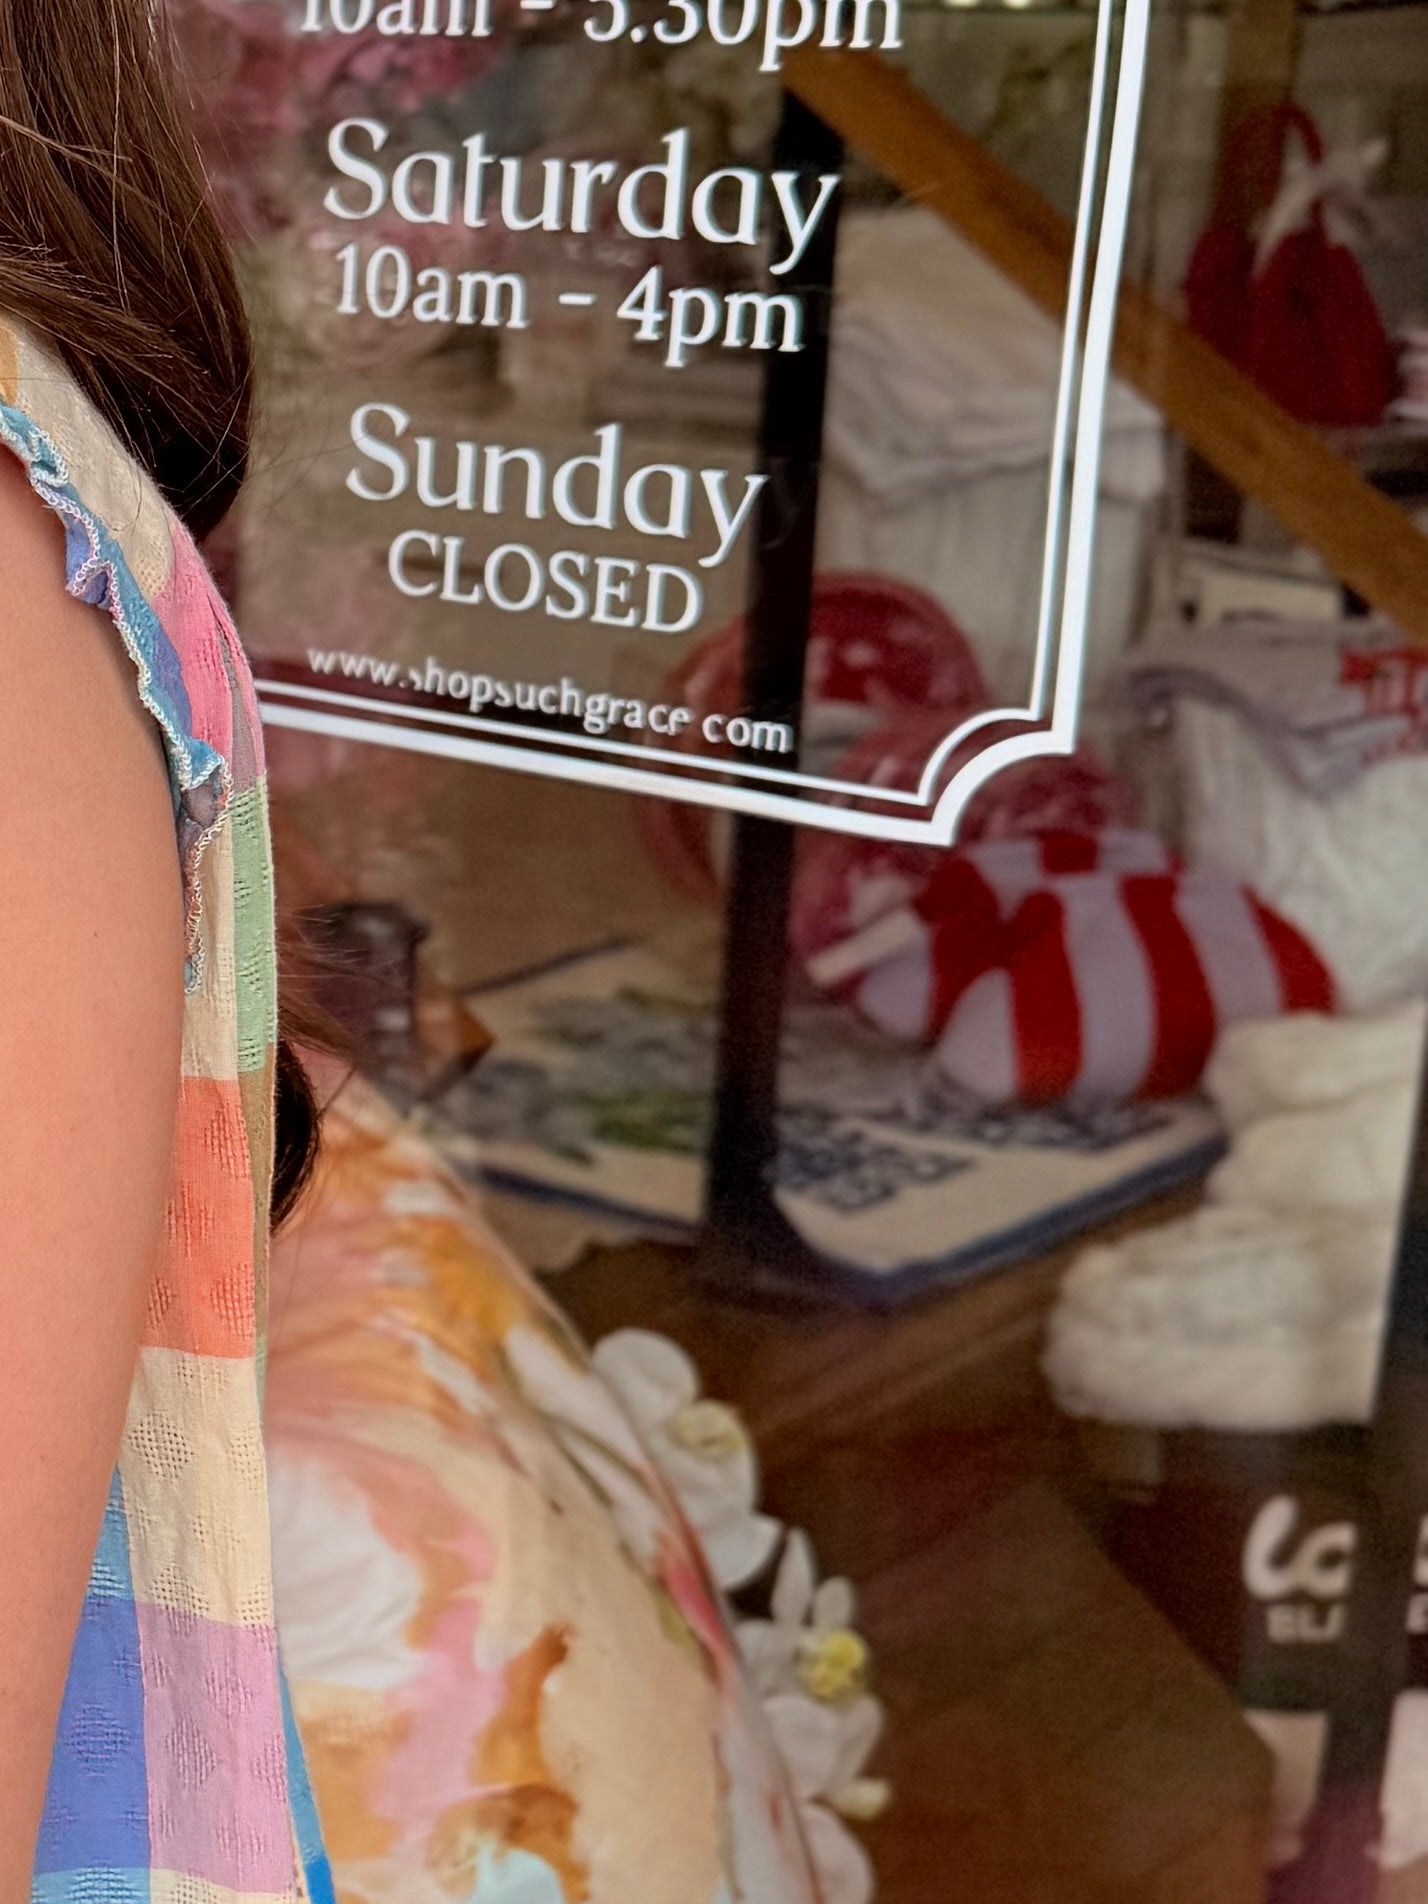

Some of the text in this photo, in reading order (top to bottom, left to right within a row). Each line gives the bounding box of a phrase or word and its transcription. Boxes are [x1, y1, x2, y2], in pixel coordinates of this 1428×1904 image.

[323, 116, 841, 275] Saturday
[334, 243, 528, 329] 10am
[617, 265, 806, 368] 4pm
[345, 401, 769, 569] Sunday
[387, 529, 704, 634] CLOSED
